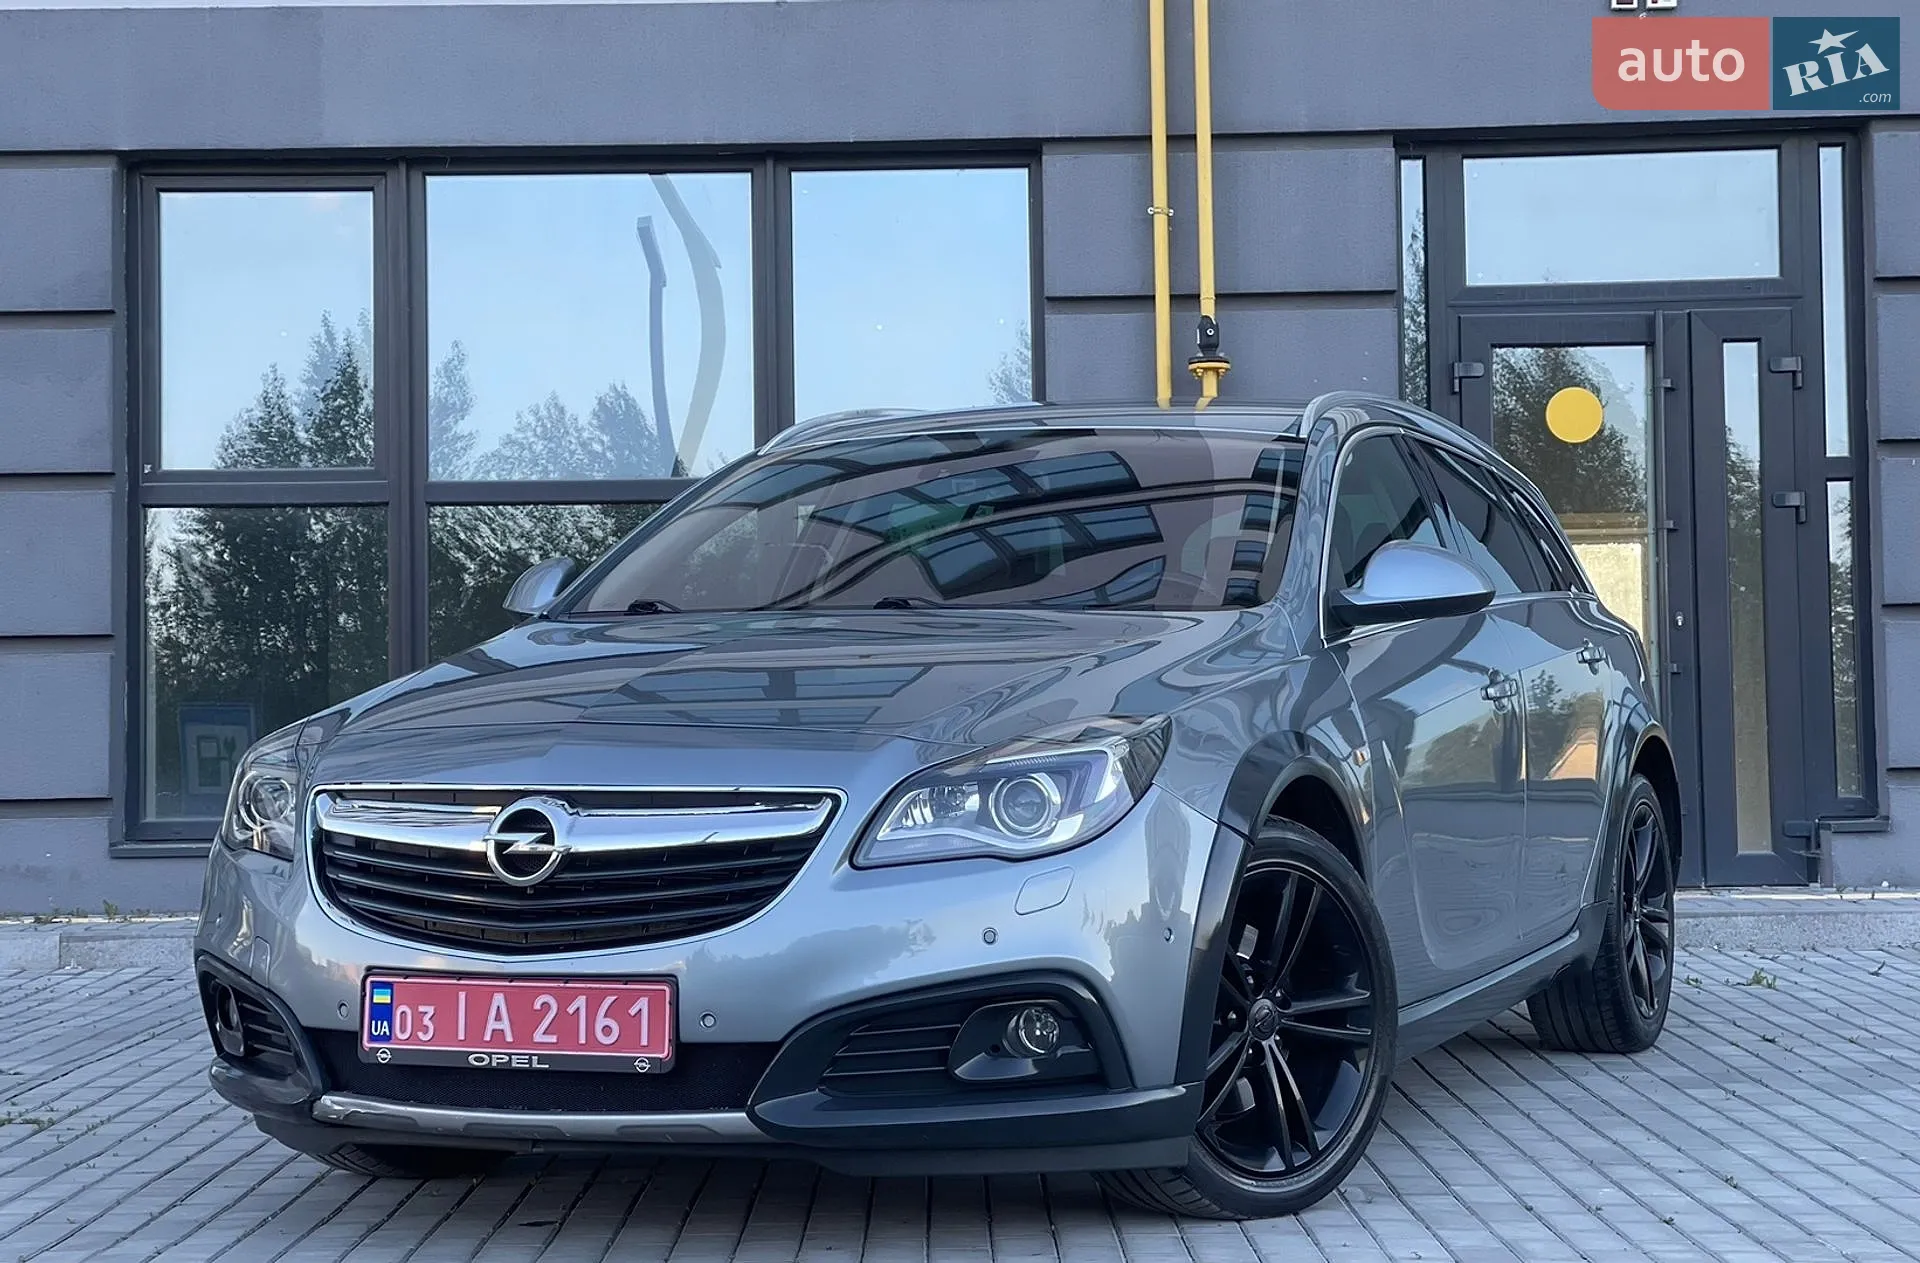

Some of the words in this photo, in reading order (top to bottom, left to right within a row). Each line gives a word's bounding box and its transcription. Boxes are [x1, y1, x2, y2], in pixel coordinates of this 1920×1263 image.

[371, 1020, 391, 1036] UA
[394, 1004, 435, 1042] 03
[532, 993, 649, 1047] 2161
[467, 1053, 550, 1069] OPEL
